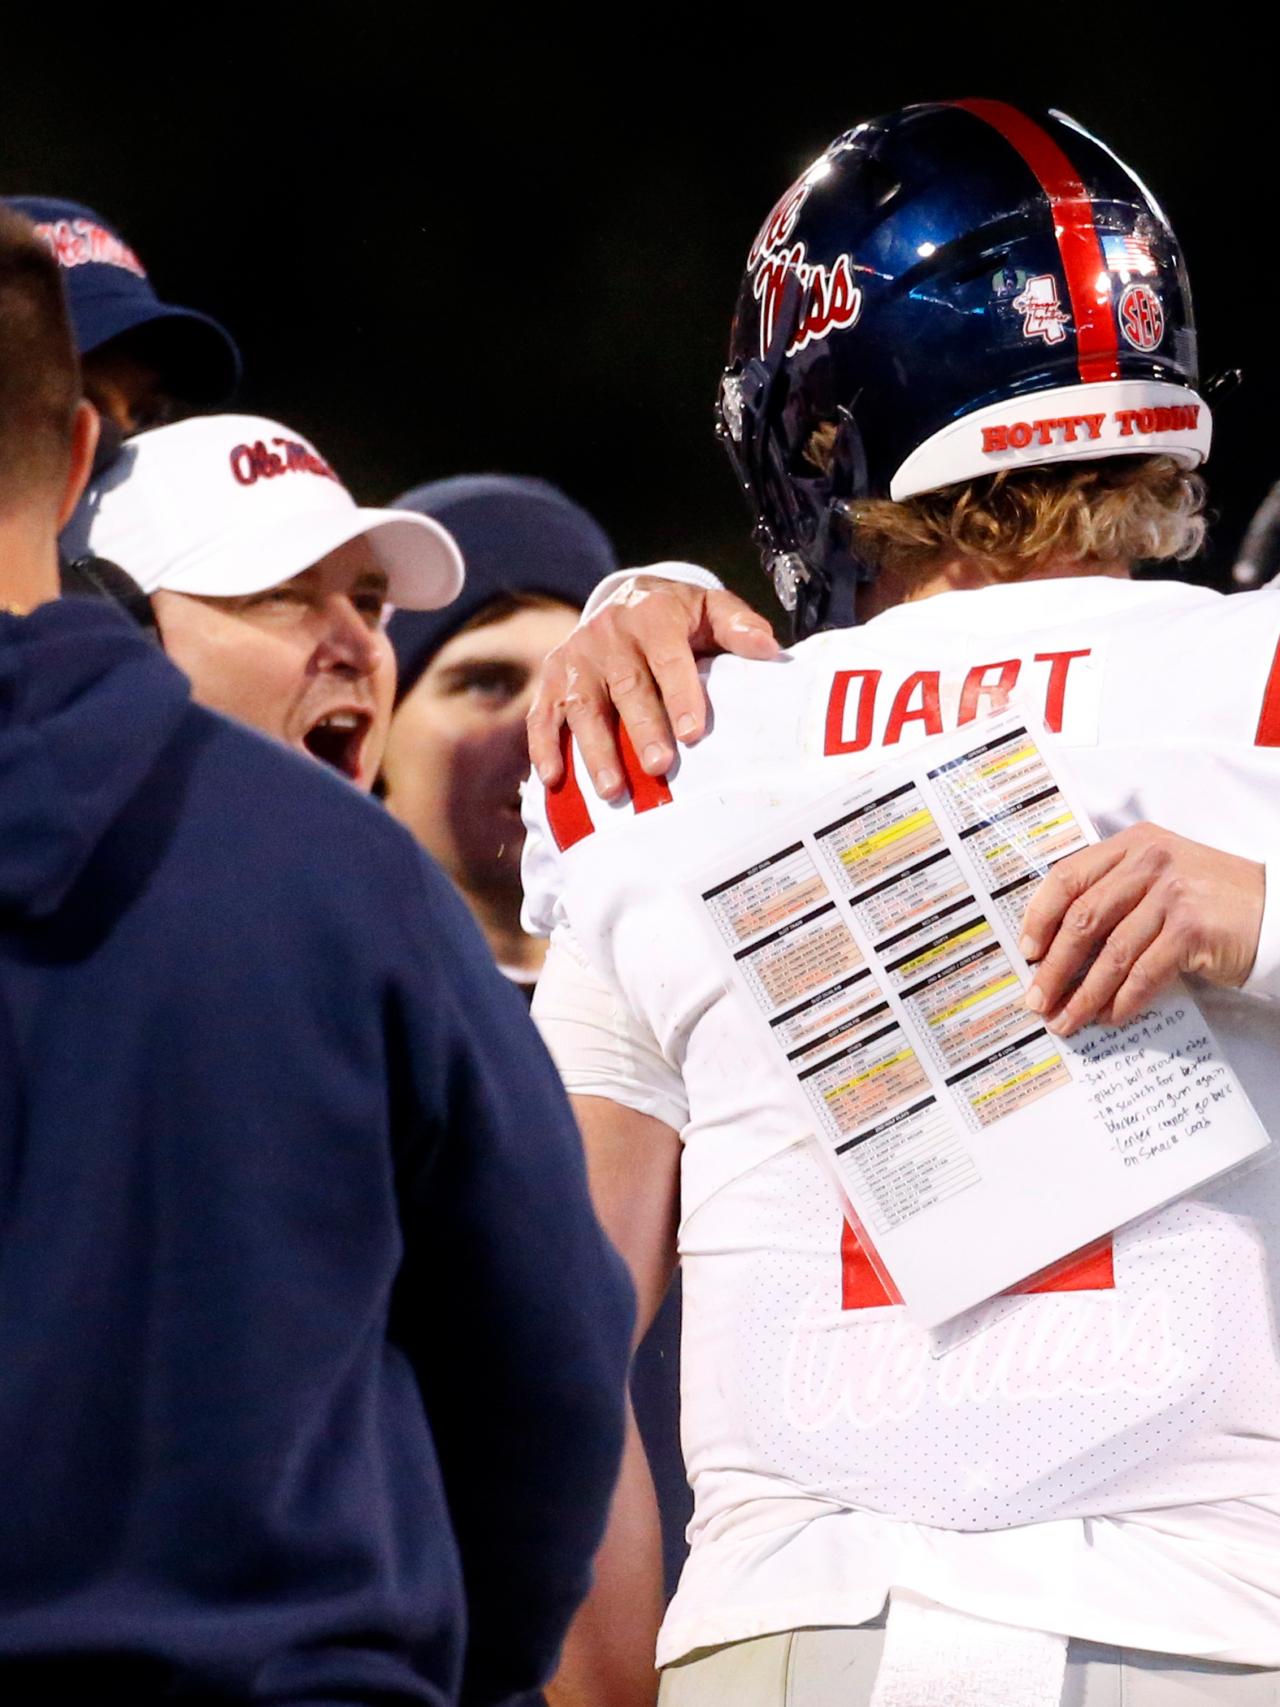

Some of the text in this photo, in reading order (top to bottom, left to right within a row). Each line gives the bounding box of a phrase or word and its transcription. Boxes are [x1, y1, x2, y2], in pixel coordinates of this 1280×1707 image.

[1121, 288, 1161, 348] SEC
[981, 413, 1107, 453] HOTTY
[1115, 404, 1200, 437] TODDY
[823, 647, 1092, 757] DART
